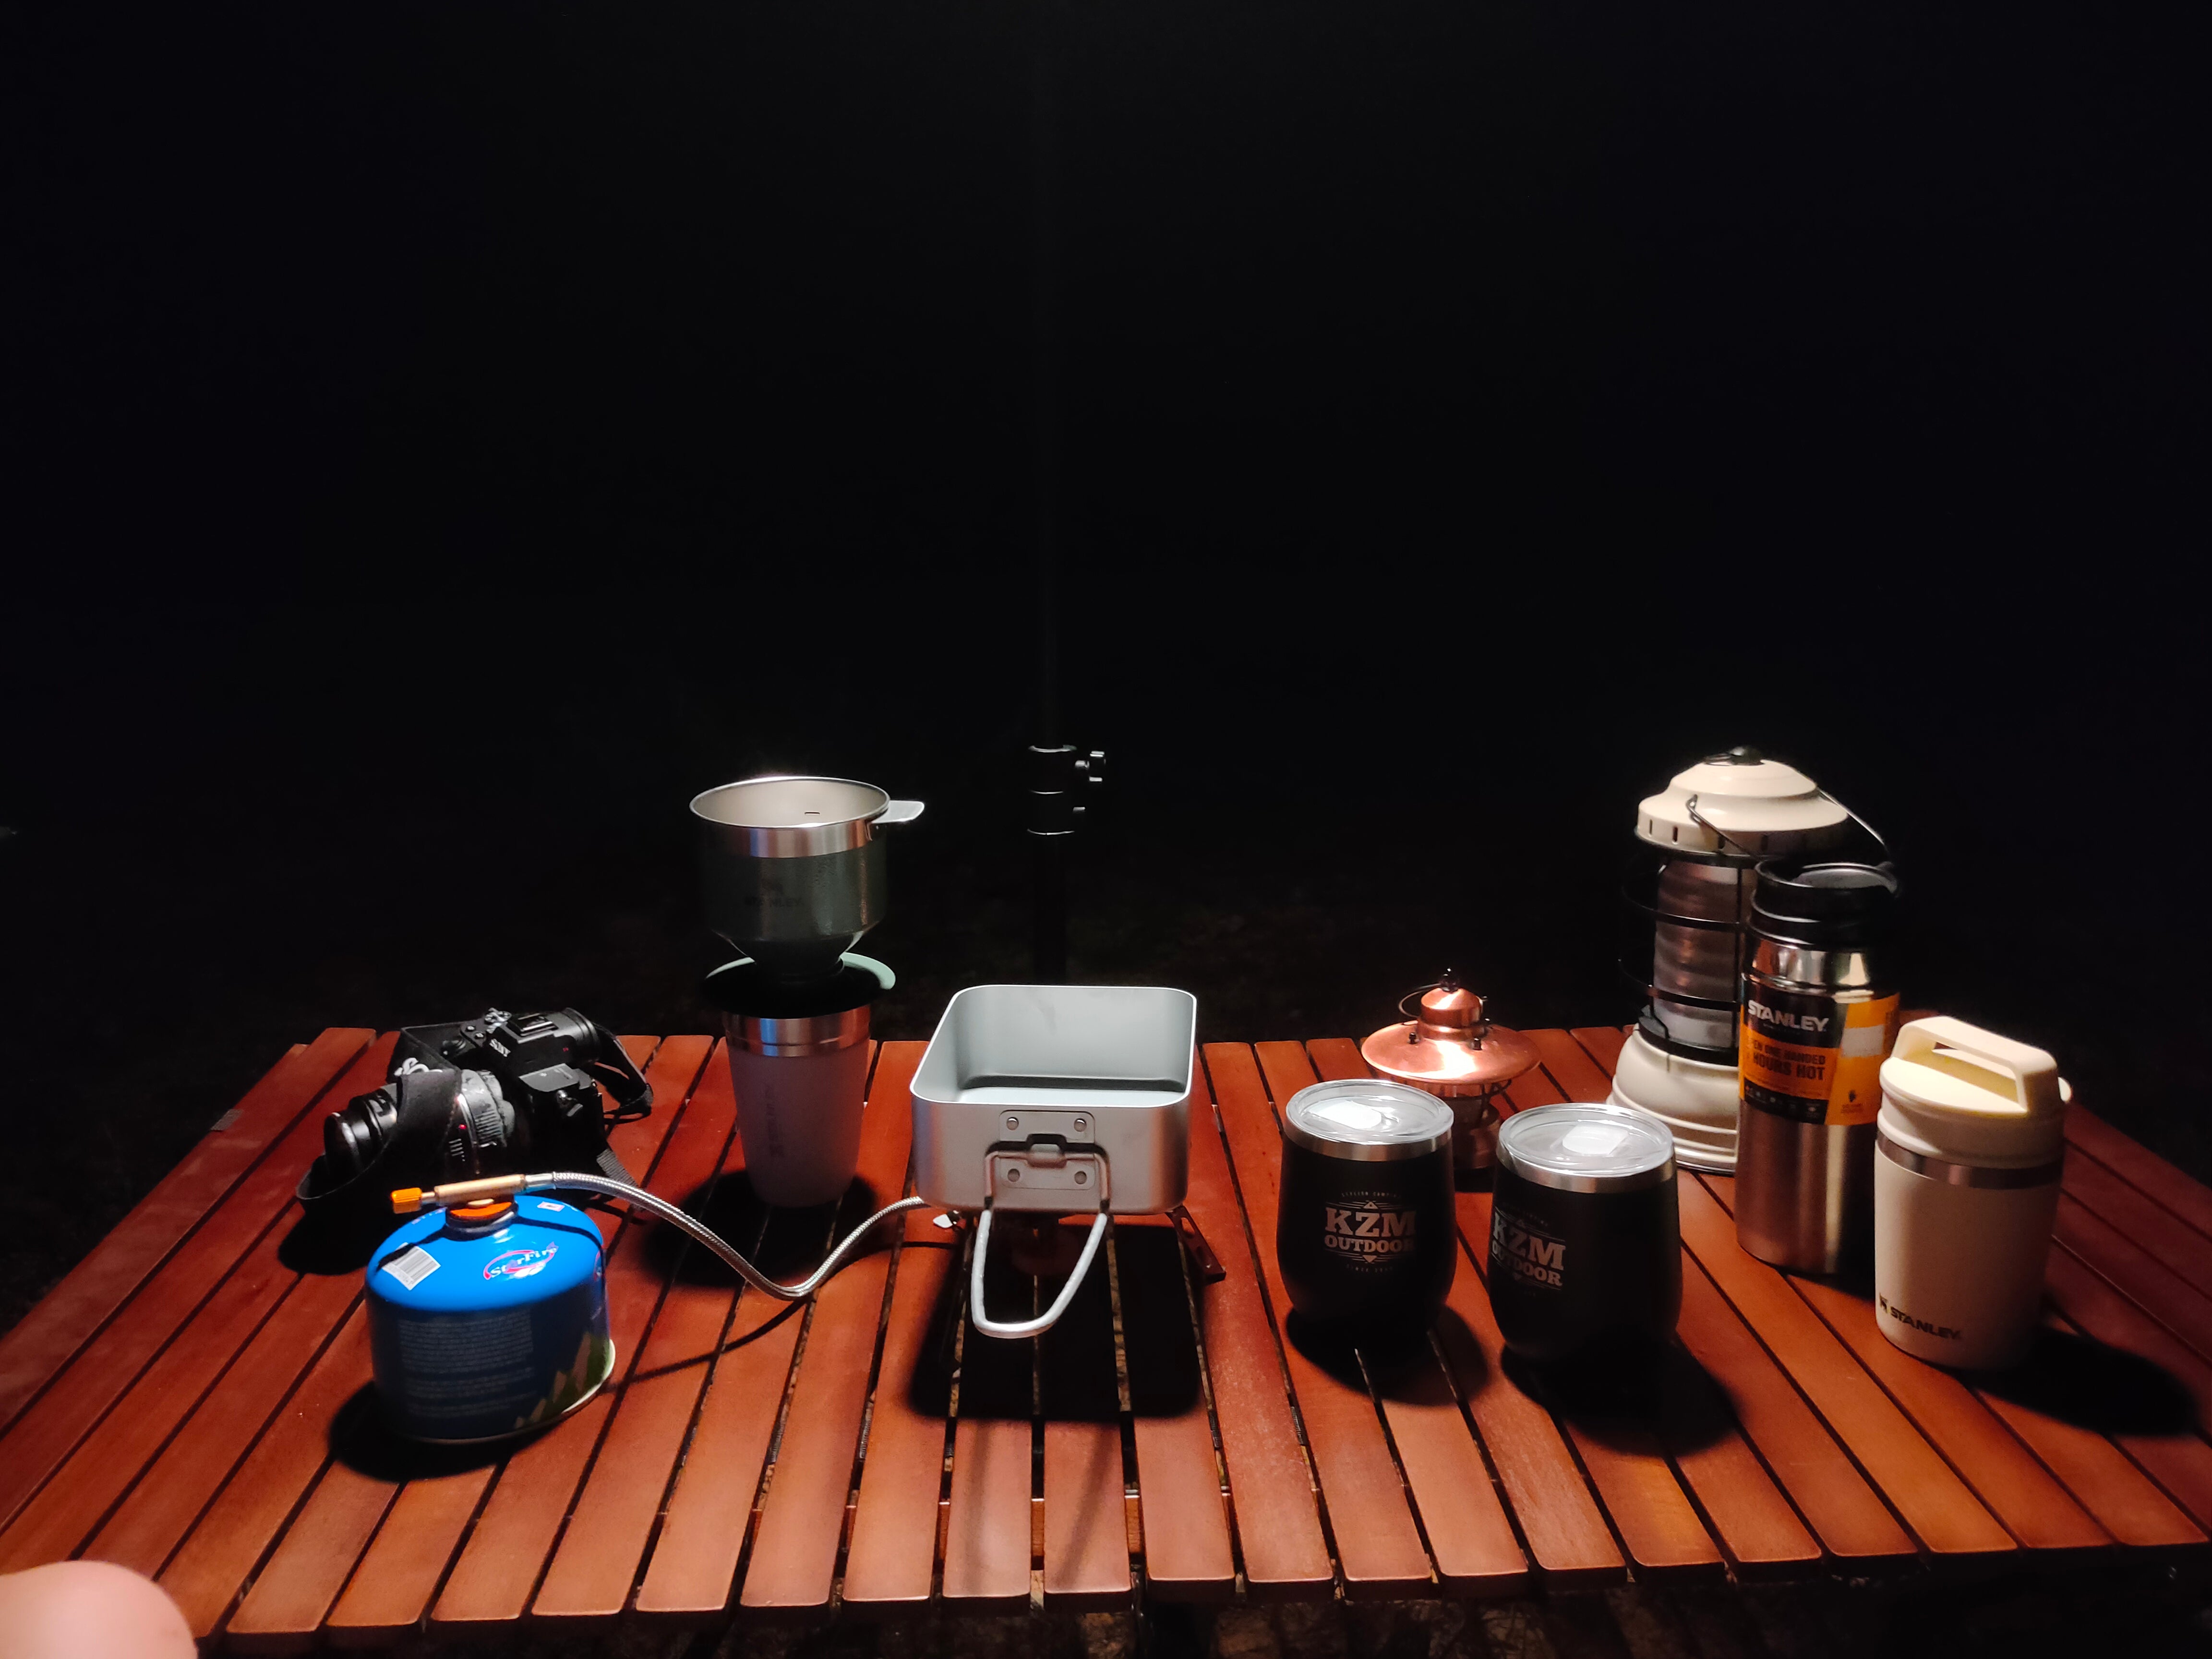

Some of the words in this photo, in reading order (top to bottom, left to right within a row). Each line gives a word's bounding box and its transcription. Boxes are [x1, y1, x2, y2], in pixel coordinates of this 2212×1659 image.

[1748, 999, 1829, 1032] STANLEY
[1796, 1063, 1826, 1080] HOT
[1324, 1207, 1417, 1238] KZM
[1324, 1234, 1416, 1253] OUTDOOR
[1493, 1211, 1566, 1271] KZM
[1890, 1306, 1961, 1339] STANLEY
